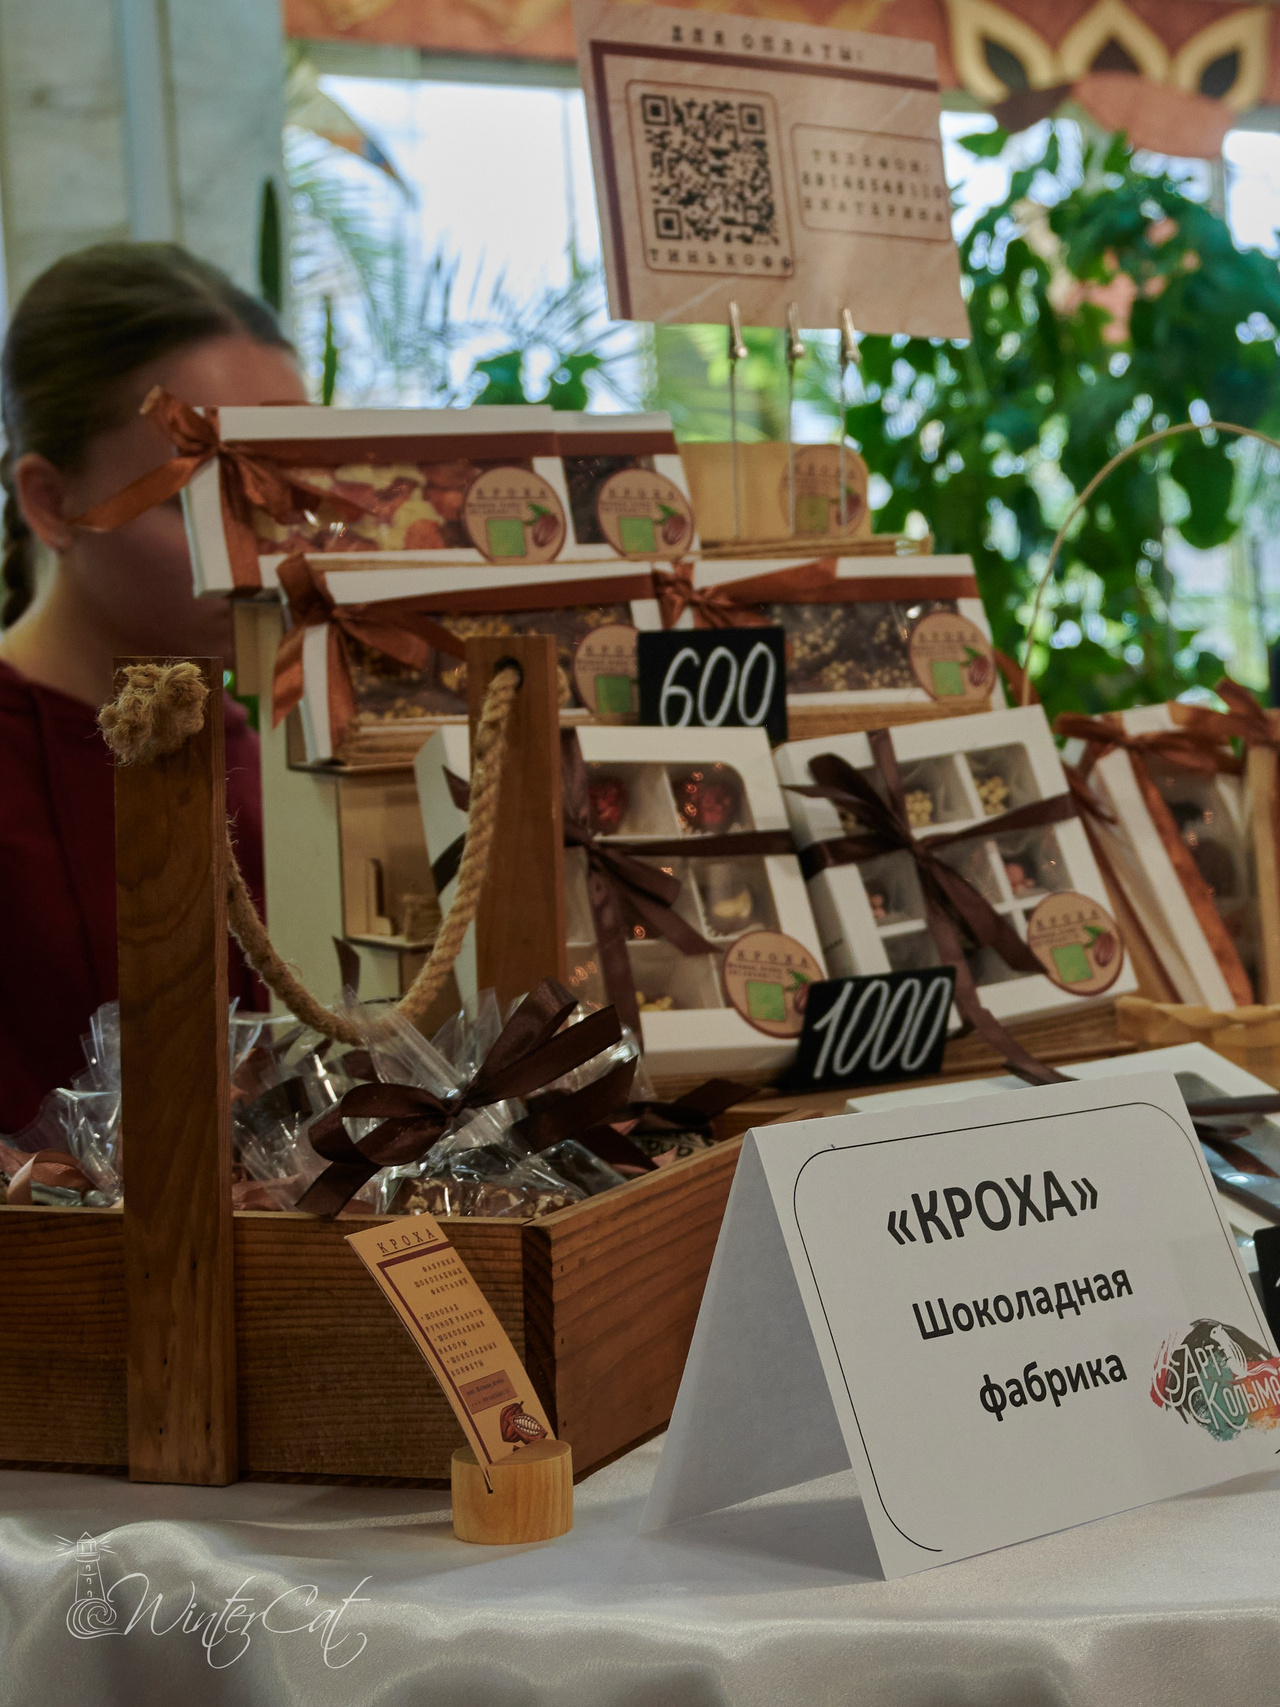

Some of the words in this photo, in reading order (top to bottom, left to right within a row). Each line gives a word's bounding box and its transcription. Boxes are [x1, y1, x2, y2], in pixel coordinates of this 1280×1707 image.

[660, 641, 776, 727] 600
[813, 976, 952, 1079] 1000
[887, 1170, 1098, 1245] «КРОХА»
[377, 1228, 435, 1253] КРОХА
[422, 1257, 456, 1273] ФАБРИКА
[430, 1277, 469, 1296] ФАНТАЗИЙ
[455, 1307, 484, 1322] РАБОТЫ
[912, 1269, 1134, 1340] Шоколадная
[437, 1340, 467, 1355] НАБОРЫ
[450, 1360, 484, 1377] КОНФЕТЫ
[979, 1354, 1127, 1422] фабрика
